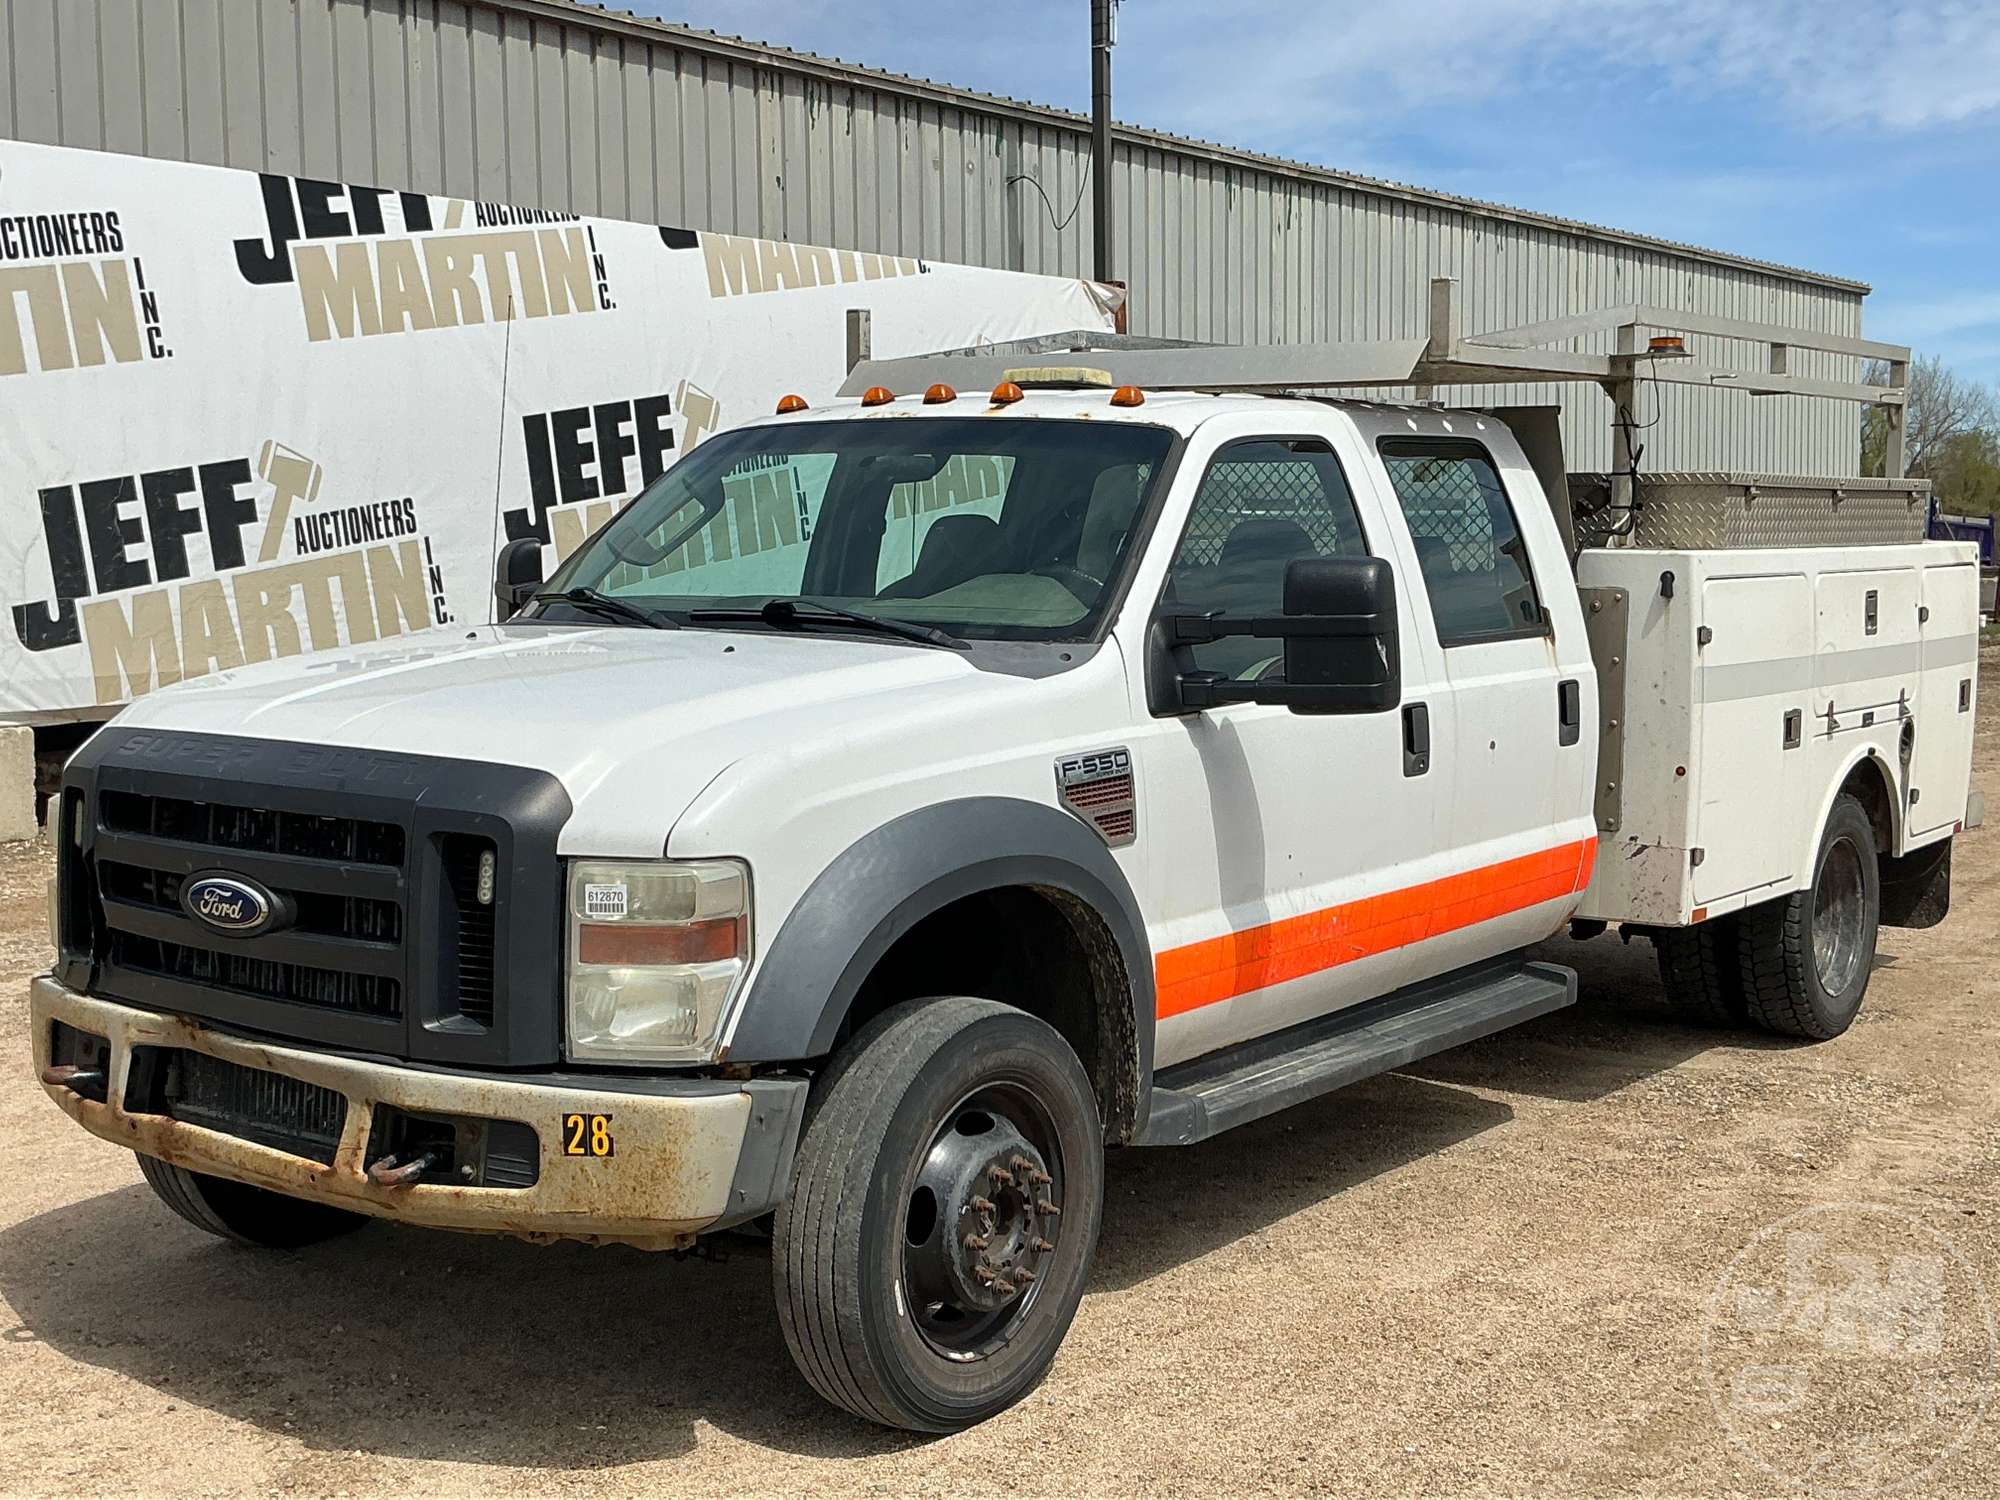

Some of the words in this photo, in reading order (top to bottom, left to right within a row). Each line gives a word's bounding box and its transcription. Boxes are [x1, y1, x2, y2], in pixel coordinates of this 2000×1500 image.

[0, 211, 124, 260] CTIONEERS
[587, 225, 617, 310] INC.
[0, 259, 144, 376] TIN
[133, 257, 173, 359] INC.
[293, 227, 597, 343] MARTIN
[503, 394, 675, 545] JEFF
[11, 458, 260, 652] JEFF
[294, 498, 417, 555] AUCTIONEERS
[82, 539, 432, 705] MARTIN
[423, 536, 455, 625] INC.
[1062, 752, 1129, 777] F-550
[200, 887, 243, 919] Ford
[588, 891, 624, 902] 612870
[567, 1114, 610, 1156] 28
